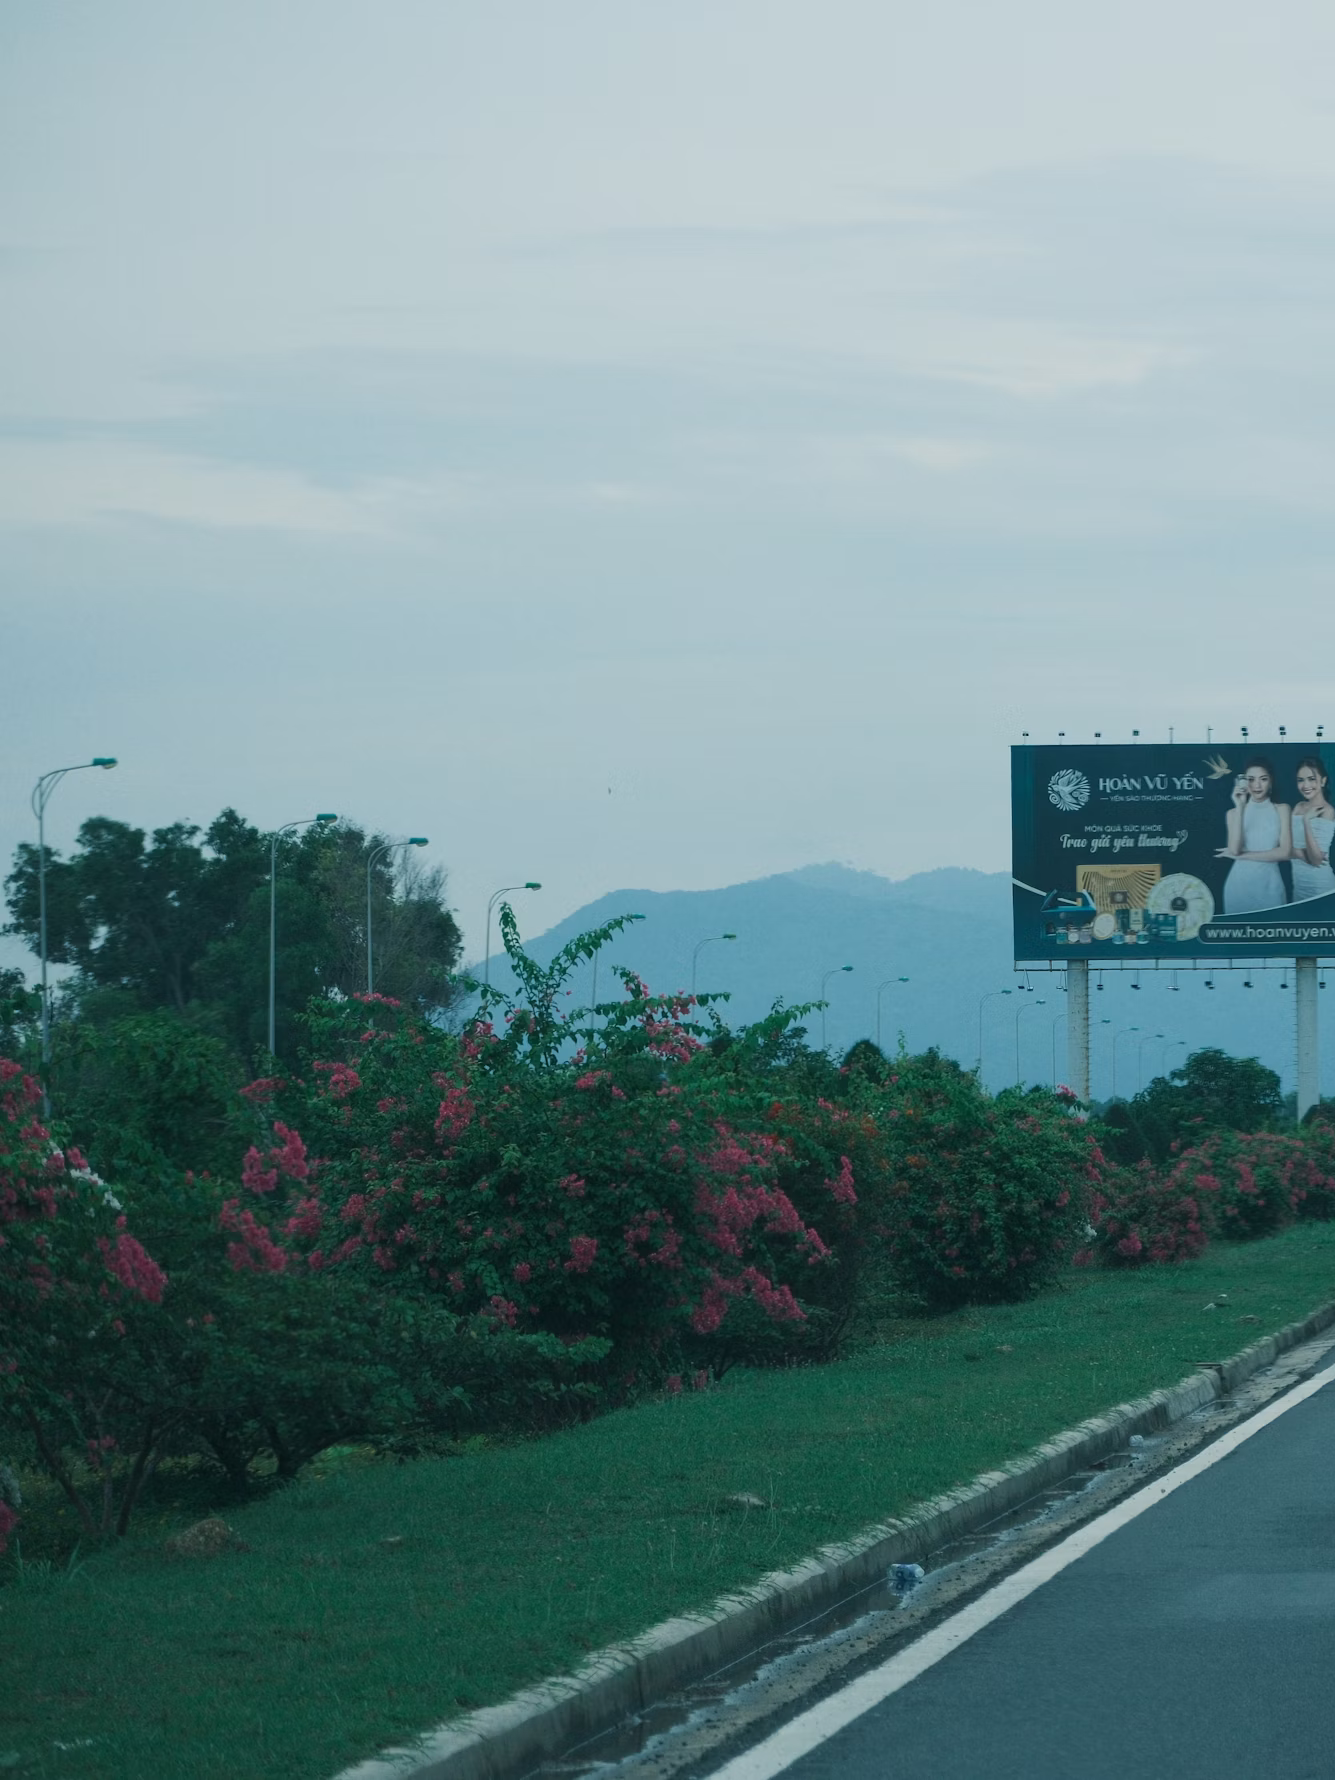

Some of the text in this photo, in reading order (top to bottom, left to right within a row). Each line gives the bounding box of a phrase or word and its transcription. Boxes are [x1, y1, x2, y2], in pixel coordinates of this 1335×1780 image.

[1099, 771, 1204, 793] HOÀN VŨ YẾN
[1060, 834, 1087, 849] Trao
[1112, 835, 1135, 853] yêu
